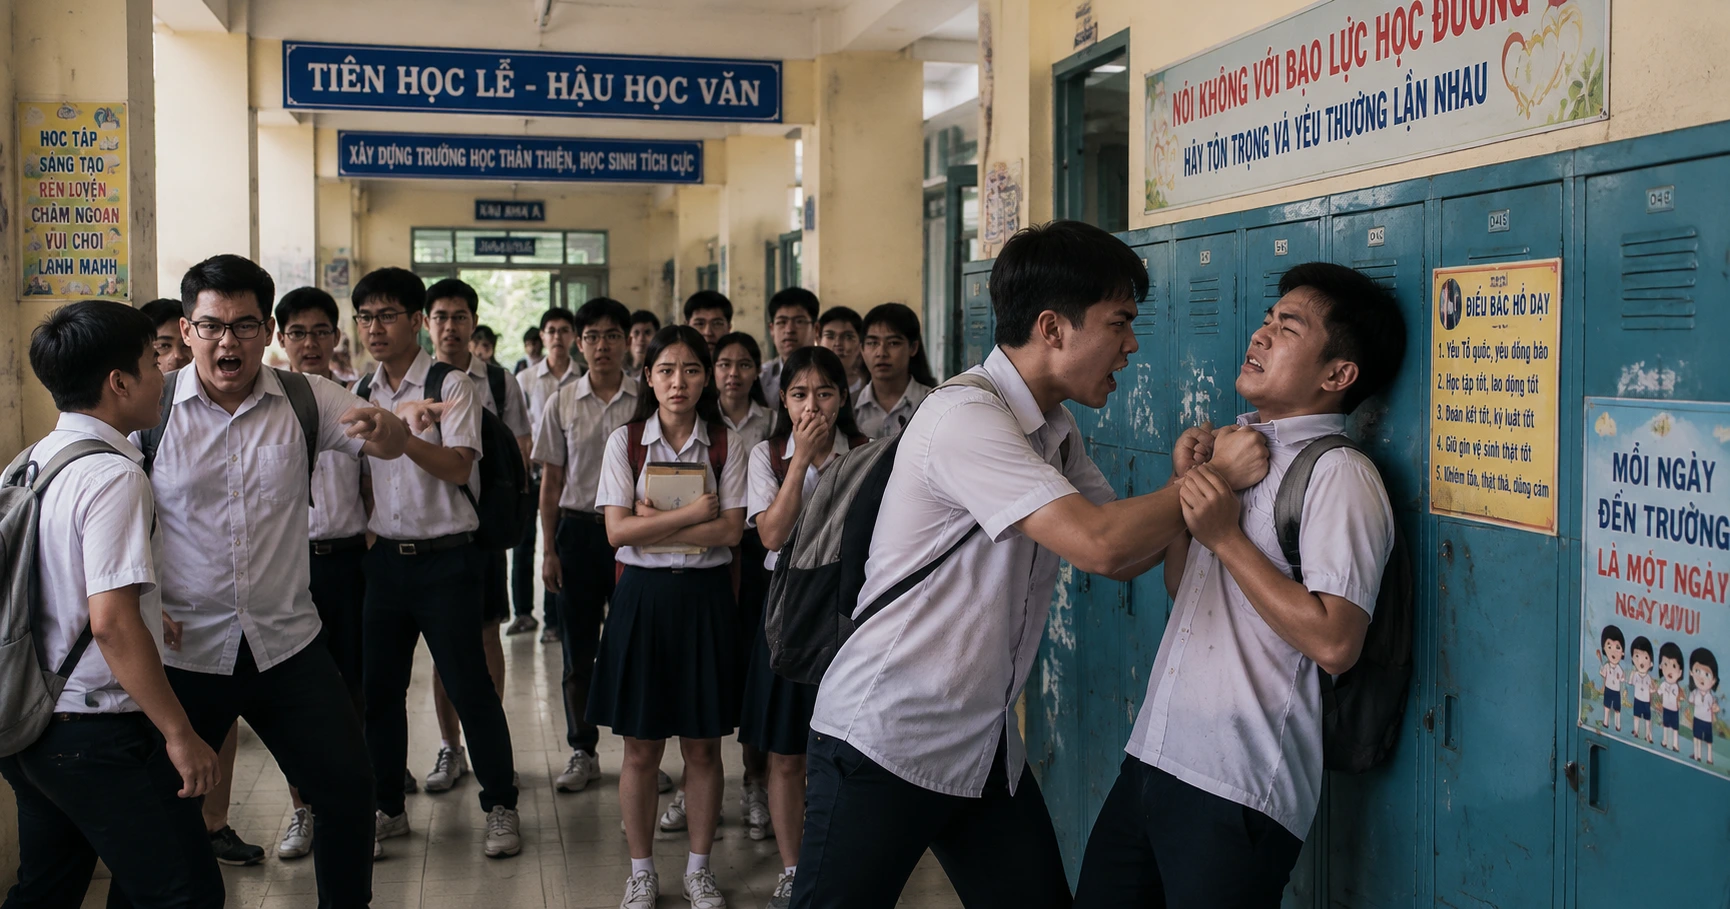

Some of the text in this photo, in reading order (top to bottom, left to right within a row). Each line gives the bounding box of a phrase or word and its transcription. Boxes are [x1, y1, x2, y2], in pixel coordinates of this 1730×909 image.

[1172, 80, 1194, 127] NÓI
[1199, 66, 1248, 119] KHÔNG
[1253, 46, 1280, 100] VỚI
[1286, 39, 1322, 97] BẠO
[1375, 0, 1424, 67] HỌC
[308, 55, 386, 93] TIÊN
[397, 66, 465, 103] HỌC
[476, 58, 515, 98] LỄ
[547, 65, 614, 107] HẬU
[624, 75, 688, 110] HỌC
[697, 71, 760, 106] VĂN
[1231, 125, 1270, 171] TRỌNG
[1434, 61, 1488, 115] NHAU
[79, 156, 104, 176] TẠO
[378, 143, 412, 170] DỰNG
[470, 148, 495, 172] HỌC
[535, 146, 576, 173] THIỆN,
[580, 151, 605, 174] HỌC
[608, 152, 637, 171] SINH
[671, 151, 695, 176] CỰC
[75, 207, 120, 224] NGOAN
[72, 232, 104, 250] CHOI
[1530, 292, 1550, 321] DẠY
[1657, 450, 1716, 493] NGÀY
[1643, 501, 1730, 551] TRƯỜNG
[1597, 542, 1620, 579] LÀ
